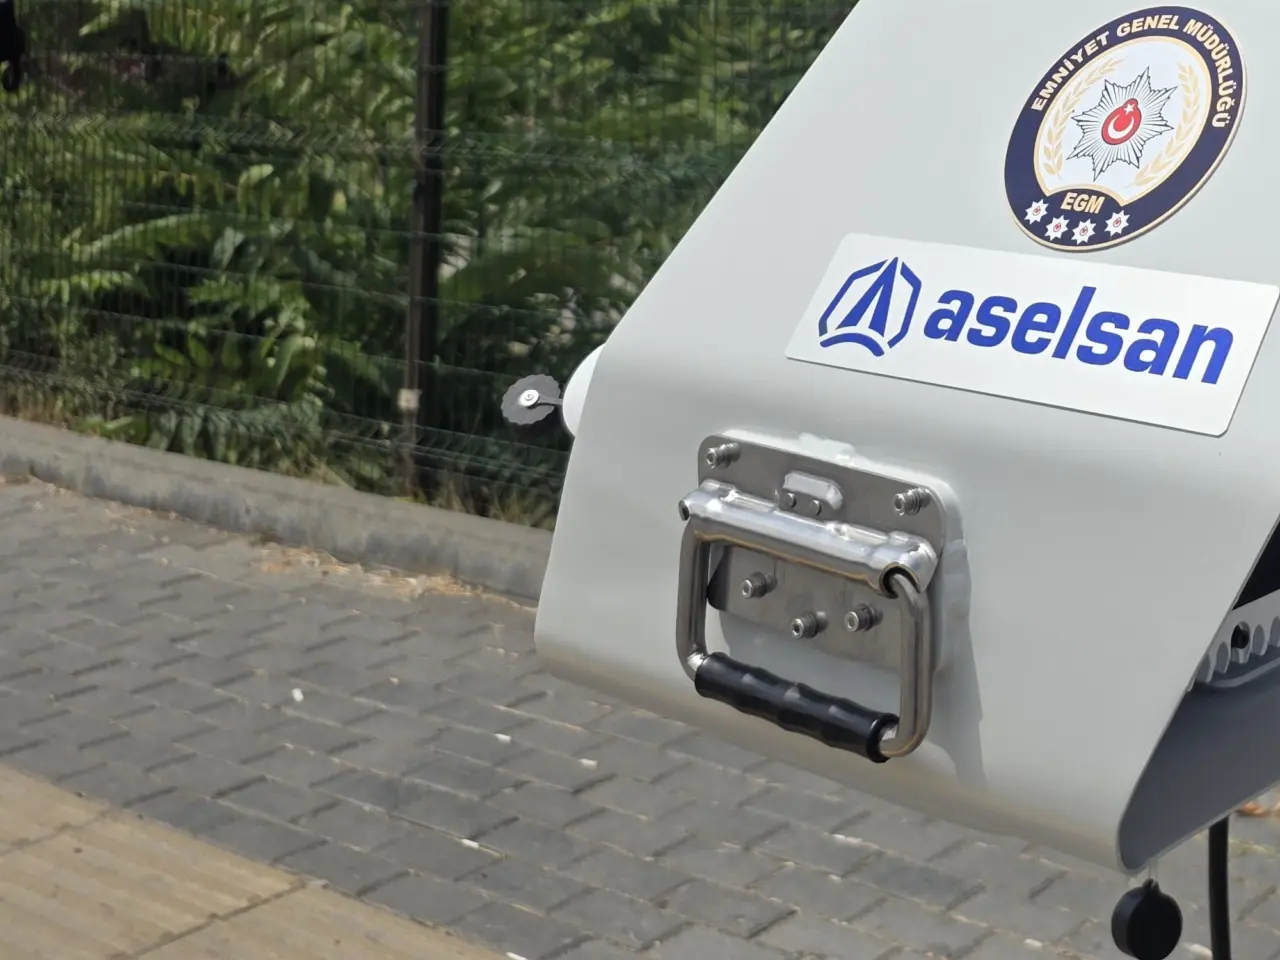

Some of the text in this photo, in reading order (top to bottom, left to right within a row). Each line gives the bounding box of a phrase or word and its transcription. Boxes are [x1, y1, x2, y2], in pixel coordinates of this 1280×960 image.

[1031, 14, 1236, 128] EMNİYET GENEL MÜDÜRLÜĞÜ
[1060, 192, 1106, 215] EGM
[923, 285, 1235, 385] aselsan
